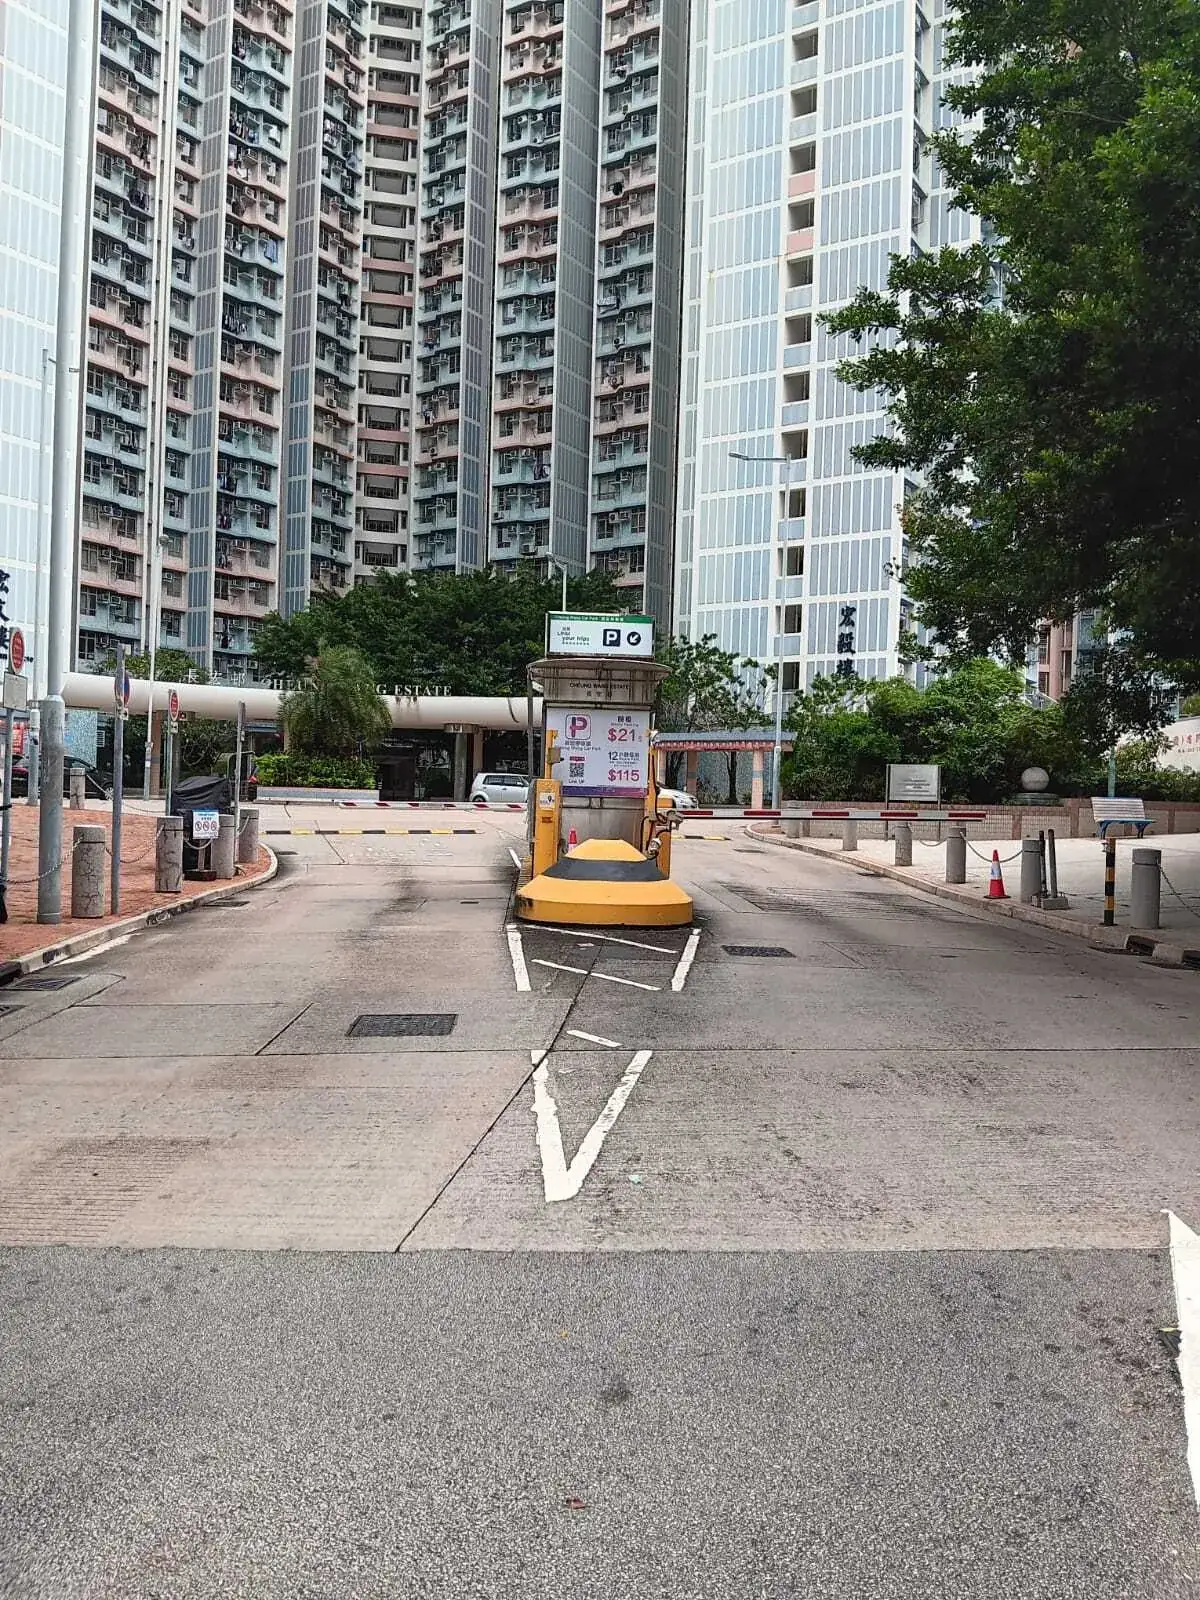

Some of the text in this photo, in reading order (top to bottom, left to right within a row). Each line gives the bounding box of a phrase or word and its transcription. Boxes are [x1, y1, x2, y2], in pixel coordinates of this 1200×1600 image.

[605, 630, 618, 645] P
[394, 684, 452, 697] ESTATE
[608, 727, 635, 742] $21
[608, 751, 619, 761] 12
[608, 768, 640, 782] $115
